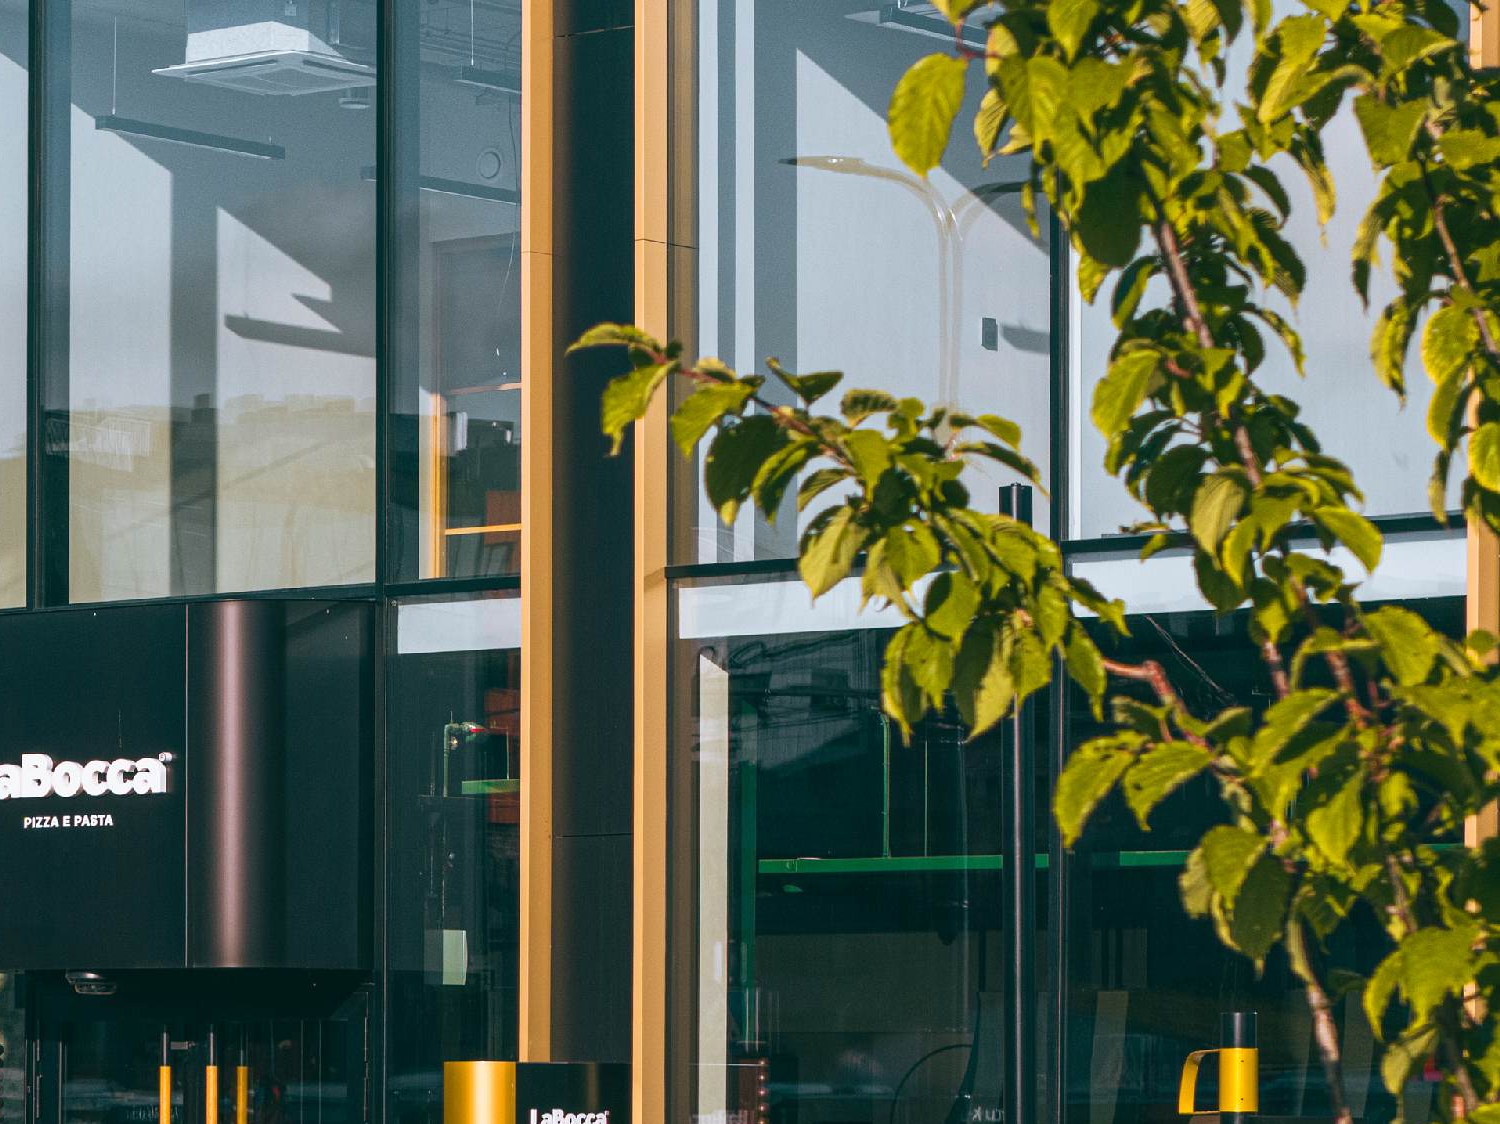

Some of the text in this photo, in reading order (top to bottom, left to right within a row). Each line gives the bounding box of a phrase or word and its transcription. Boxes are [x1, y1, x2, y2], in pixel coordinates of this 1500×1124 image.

[23, 814, 113, 828] PIZZA E PASTA
